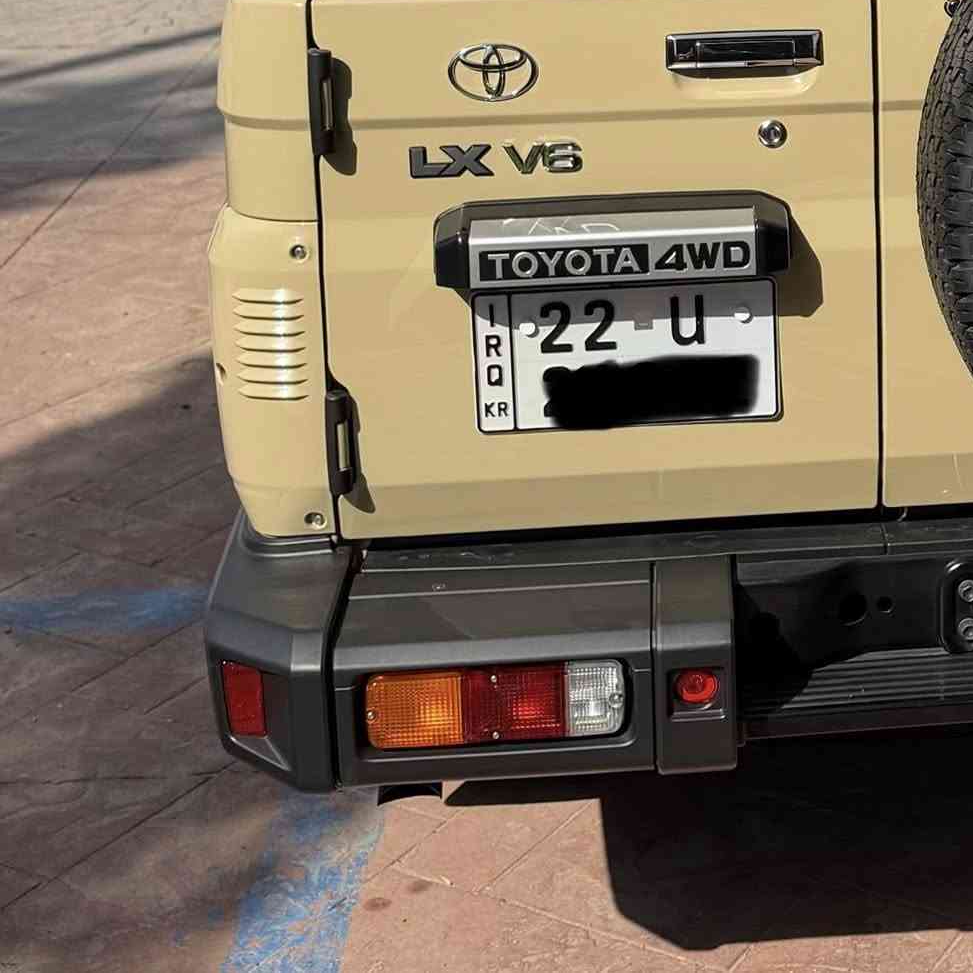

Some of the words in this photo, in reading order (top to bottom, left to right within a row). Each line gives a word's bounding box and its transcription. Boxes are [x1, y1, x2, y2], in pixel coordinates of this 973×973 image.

[409, 144, 495, 178] LX
[501, 138, 583, 175] V6
[487, 247, 642, 280] TOYOTA
[654, 240, 751, 273] 4WD
[539, 298, 618, 354] 22
[670, 294, 706, 347] U
[485, 303, 504, 388] IRQ
[484, 401, 509, 418] KR
